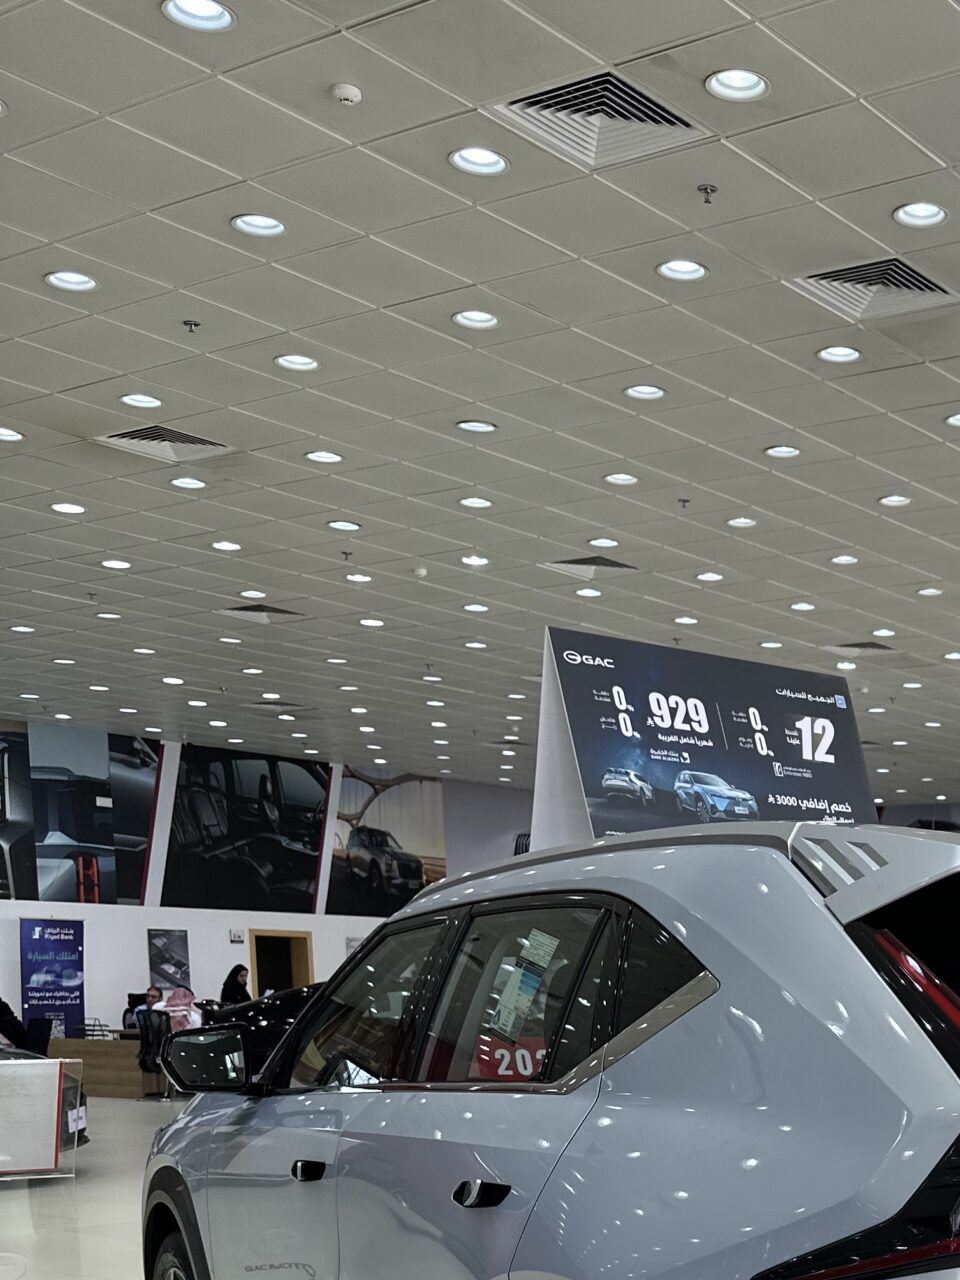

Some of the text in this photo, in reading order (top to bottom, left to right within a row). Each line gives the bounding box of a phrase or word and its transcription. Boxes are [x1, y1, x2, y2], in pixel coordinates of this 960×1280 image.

[582, 655, 615, 668] GAC
[776, 688, 807, 700] للسيارات
[648, 692, 709, 734] 929
[795, 716, 835, 764] 12
[776, 795, 852, 814] خصم إضافي 3000
